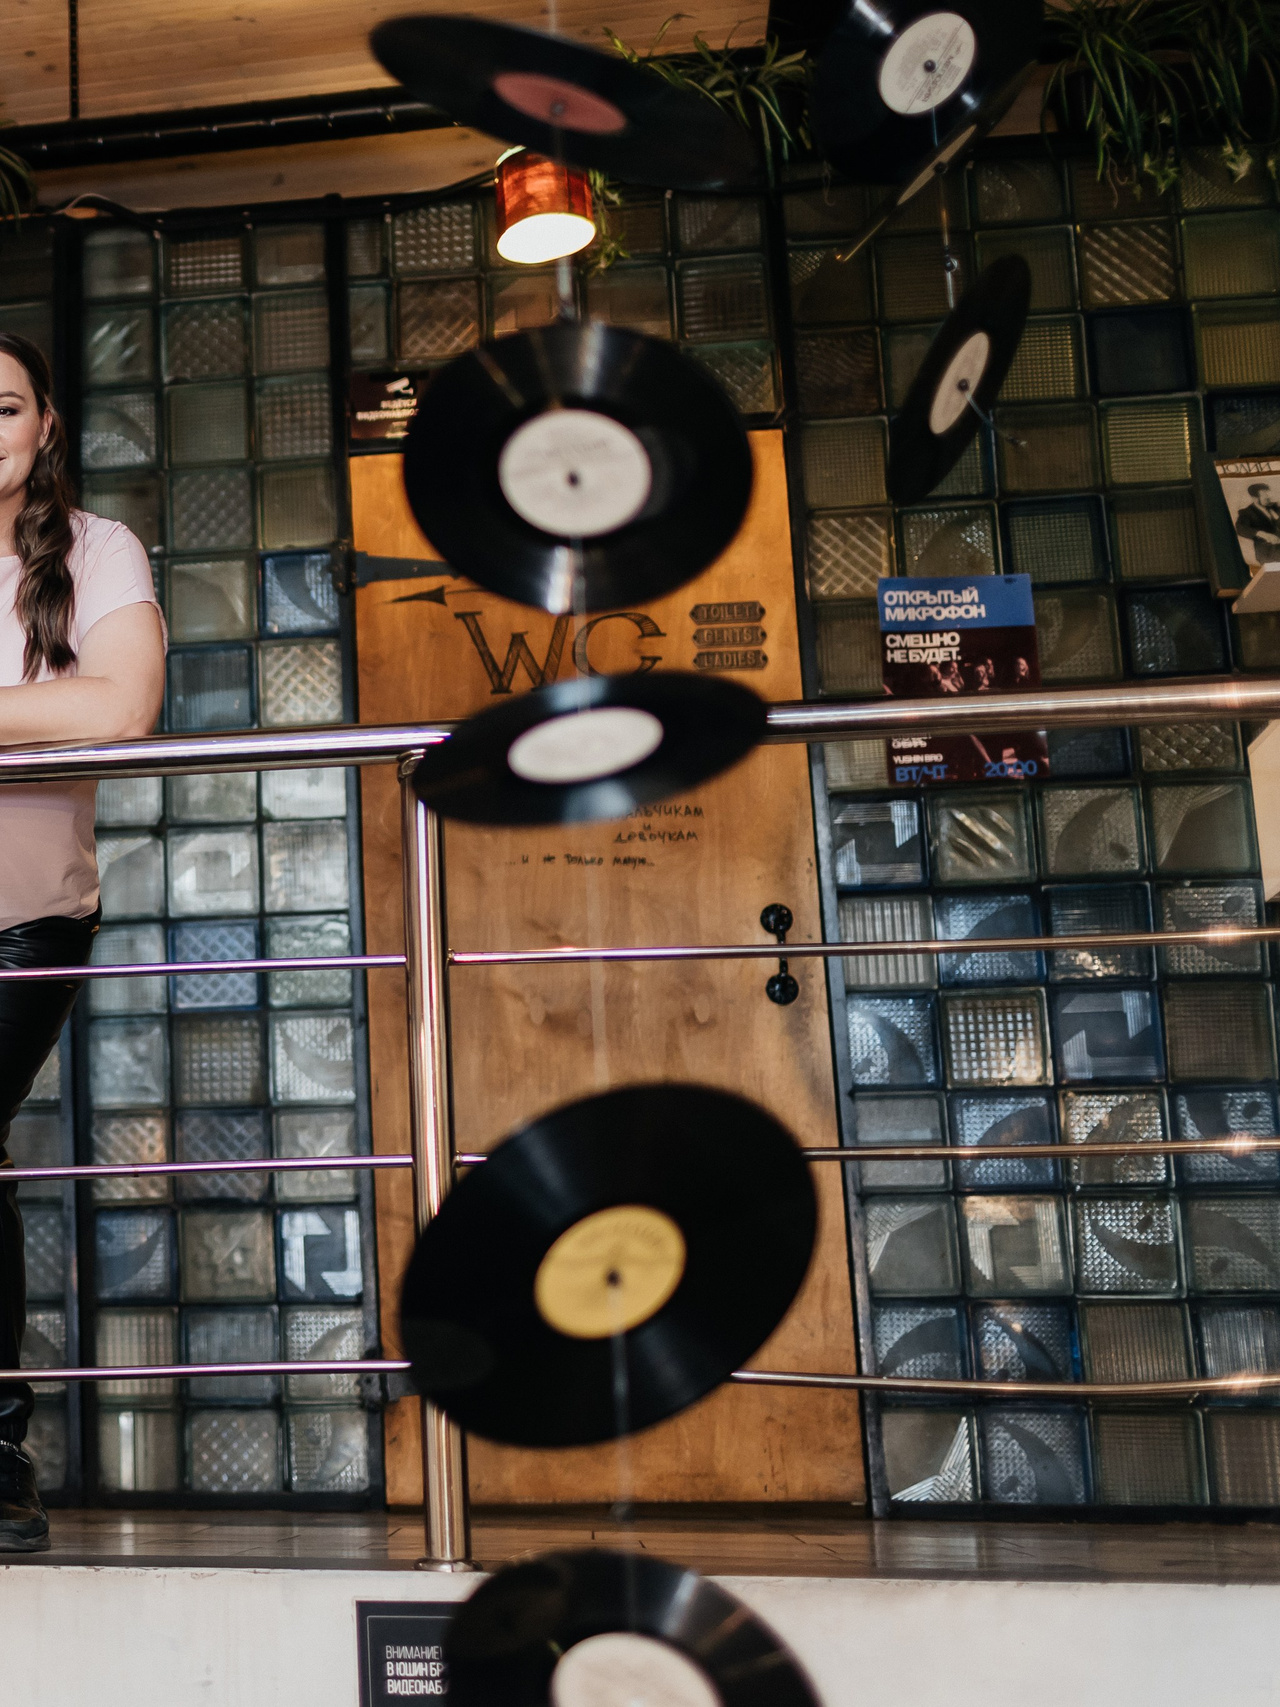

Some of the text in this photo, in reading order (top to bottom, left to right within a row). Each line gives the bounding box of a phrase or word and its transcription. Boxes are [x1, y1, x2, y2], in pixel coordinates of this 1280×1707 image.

[883, 586, 980, 606] ОТКРЫТЫЙ
[701, 604, 751, 619] TOILET
[884, 604, 986, 622] МИКРОФОН
[704, 627, 752, 643] GENTS
[886, 631, 960, 648] СМЕШНО
[454, 610, 667, 694] WC
[704, 650, 756, 667] LADIES
[886, 647, 962, 665] НЕ БУДЕТ.
[925, 753, 943, 763] BRO
[386, 1661, 446, 1677] В ЮШИН БР
[387, 1679, 448, 1696] ВИДЕОНАБ
